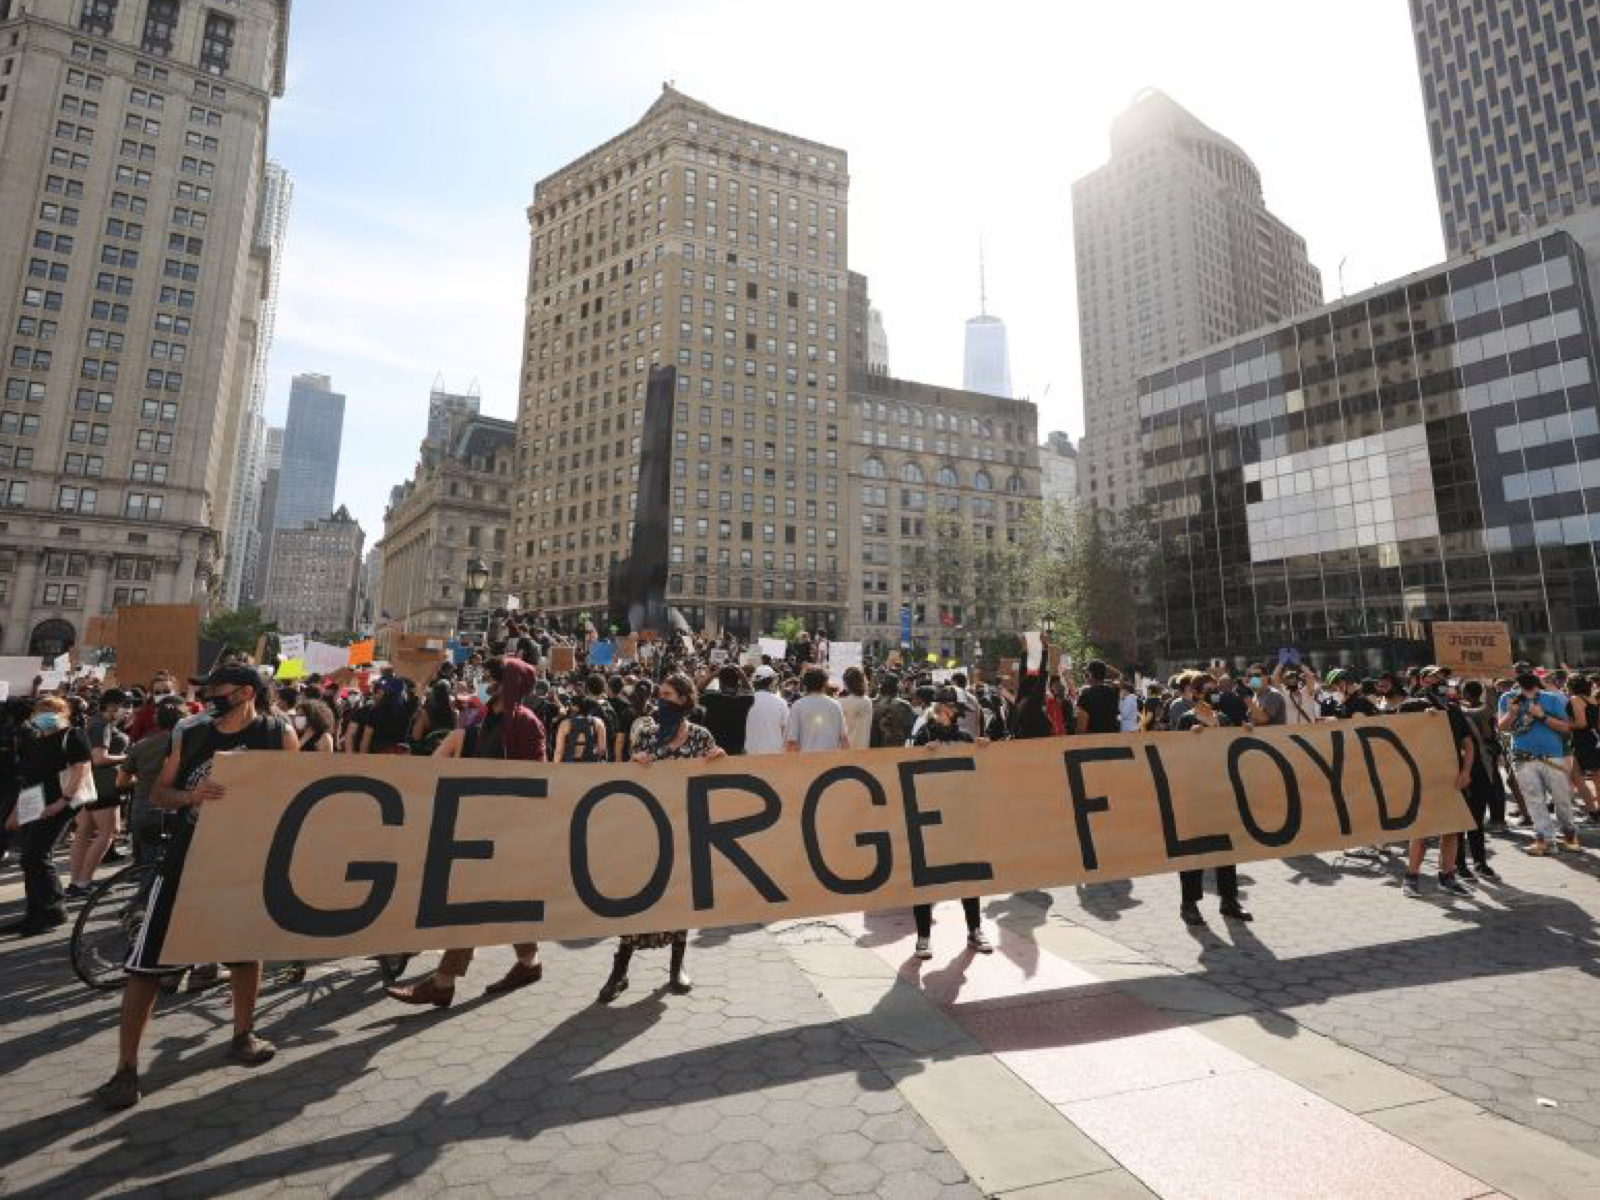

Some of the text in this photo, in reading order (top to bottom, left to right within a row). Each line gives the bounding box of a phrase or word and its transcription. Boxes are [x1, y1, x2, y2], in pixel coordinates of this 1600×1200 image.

[1448, 634, 1497, 647] JUSTICE
[261, 726, 1421, 938] GEORGE FLOYD
